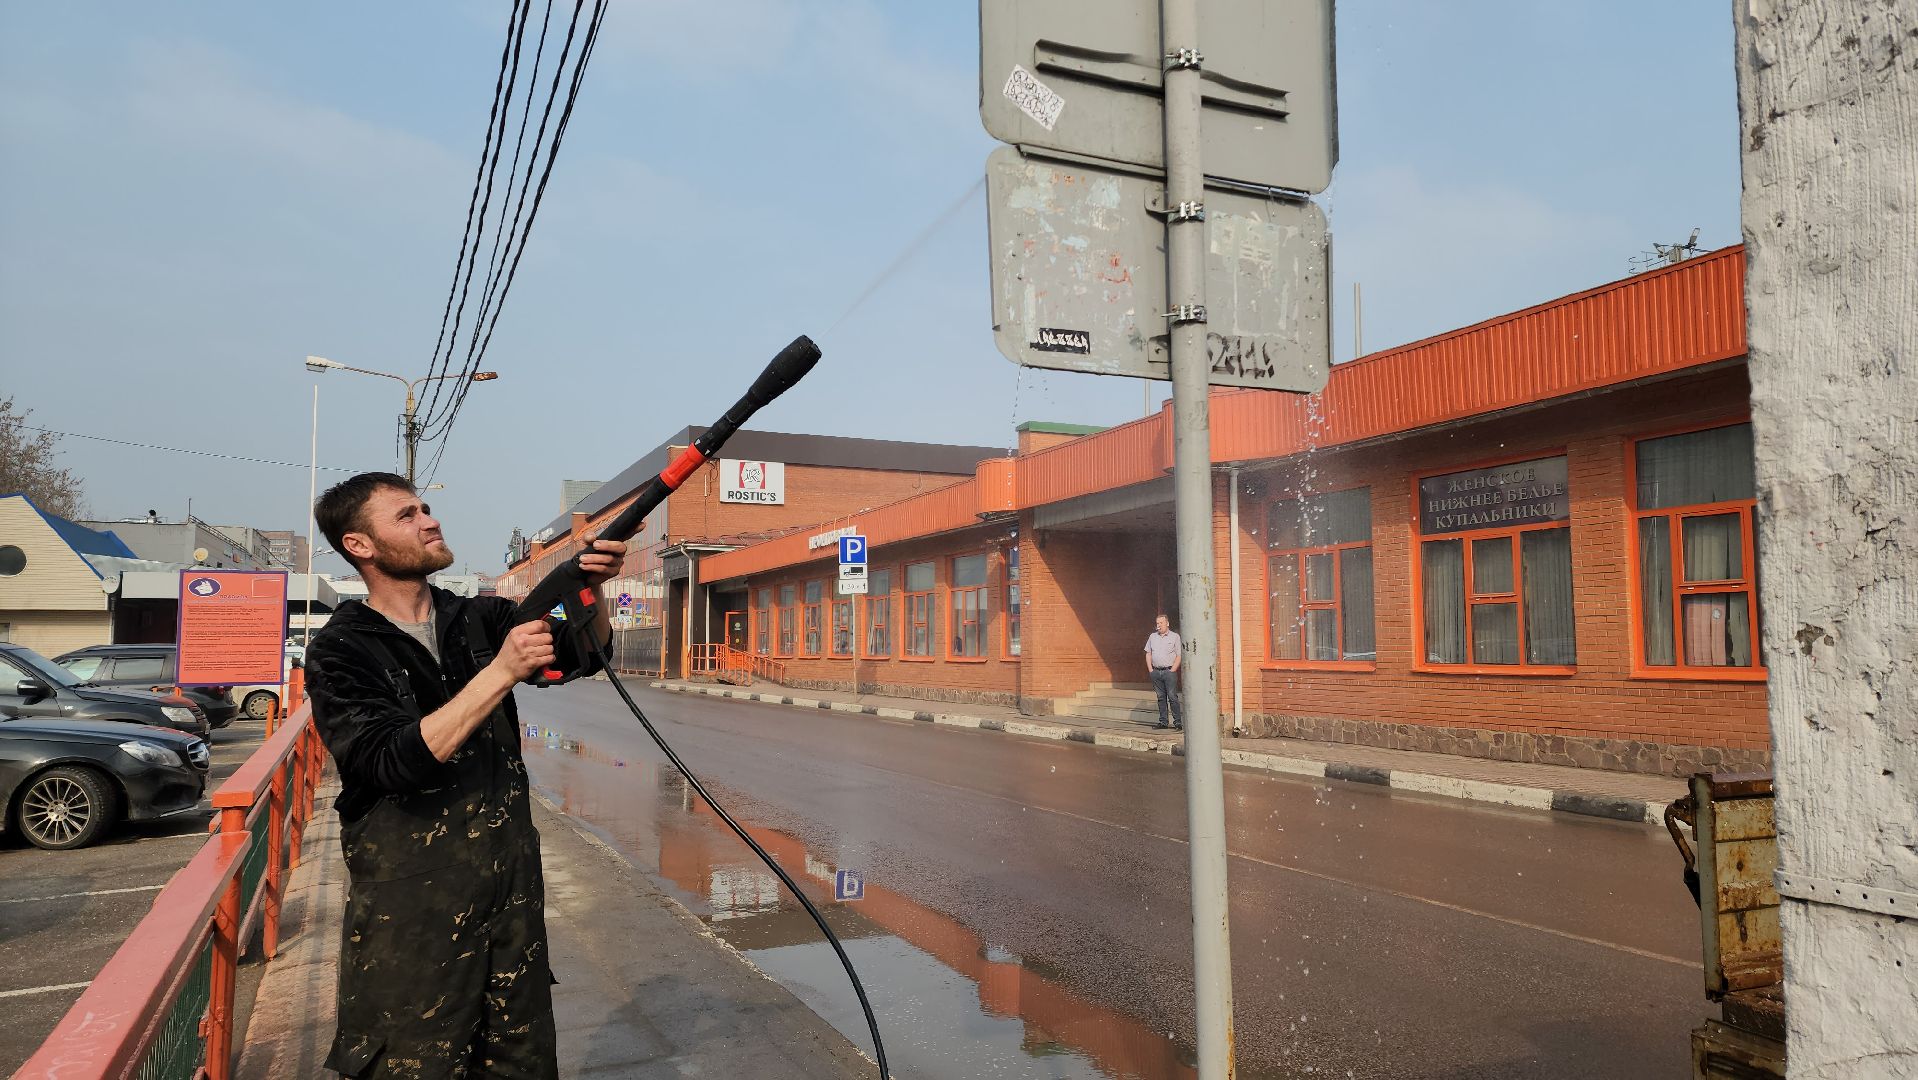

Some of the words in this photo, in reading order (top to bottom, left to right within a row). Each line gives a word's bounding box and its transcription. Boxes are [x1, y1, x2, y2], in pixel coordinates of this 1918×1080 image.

[1447, 468, 1536, 494] ЖЕНСКОЕ
[1428, 491, 1503, 513] НИЖНЕЕ
[1507, 482, 1564, 502] БЕЛЬЕ
[1436, 502, 1556, 529] КУПАЛЬНИКИ
[846, 538, 862, 562] P
